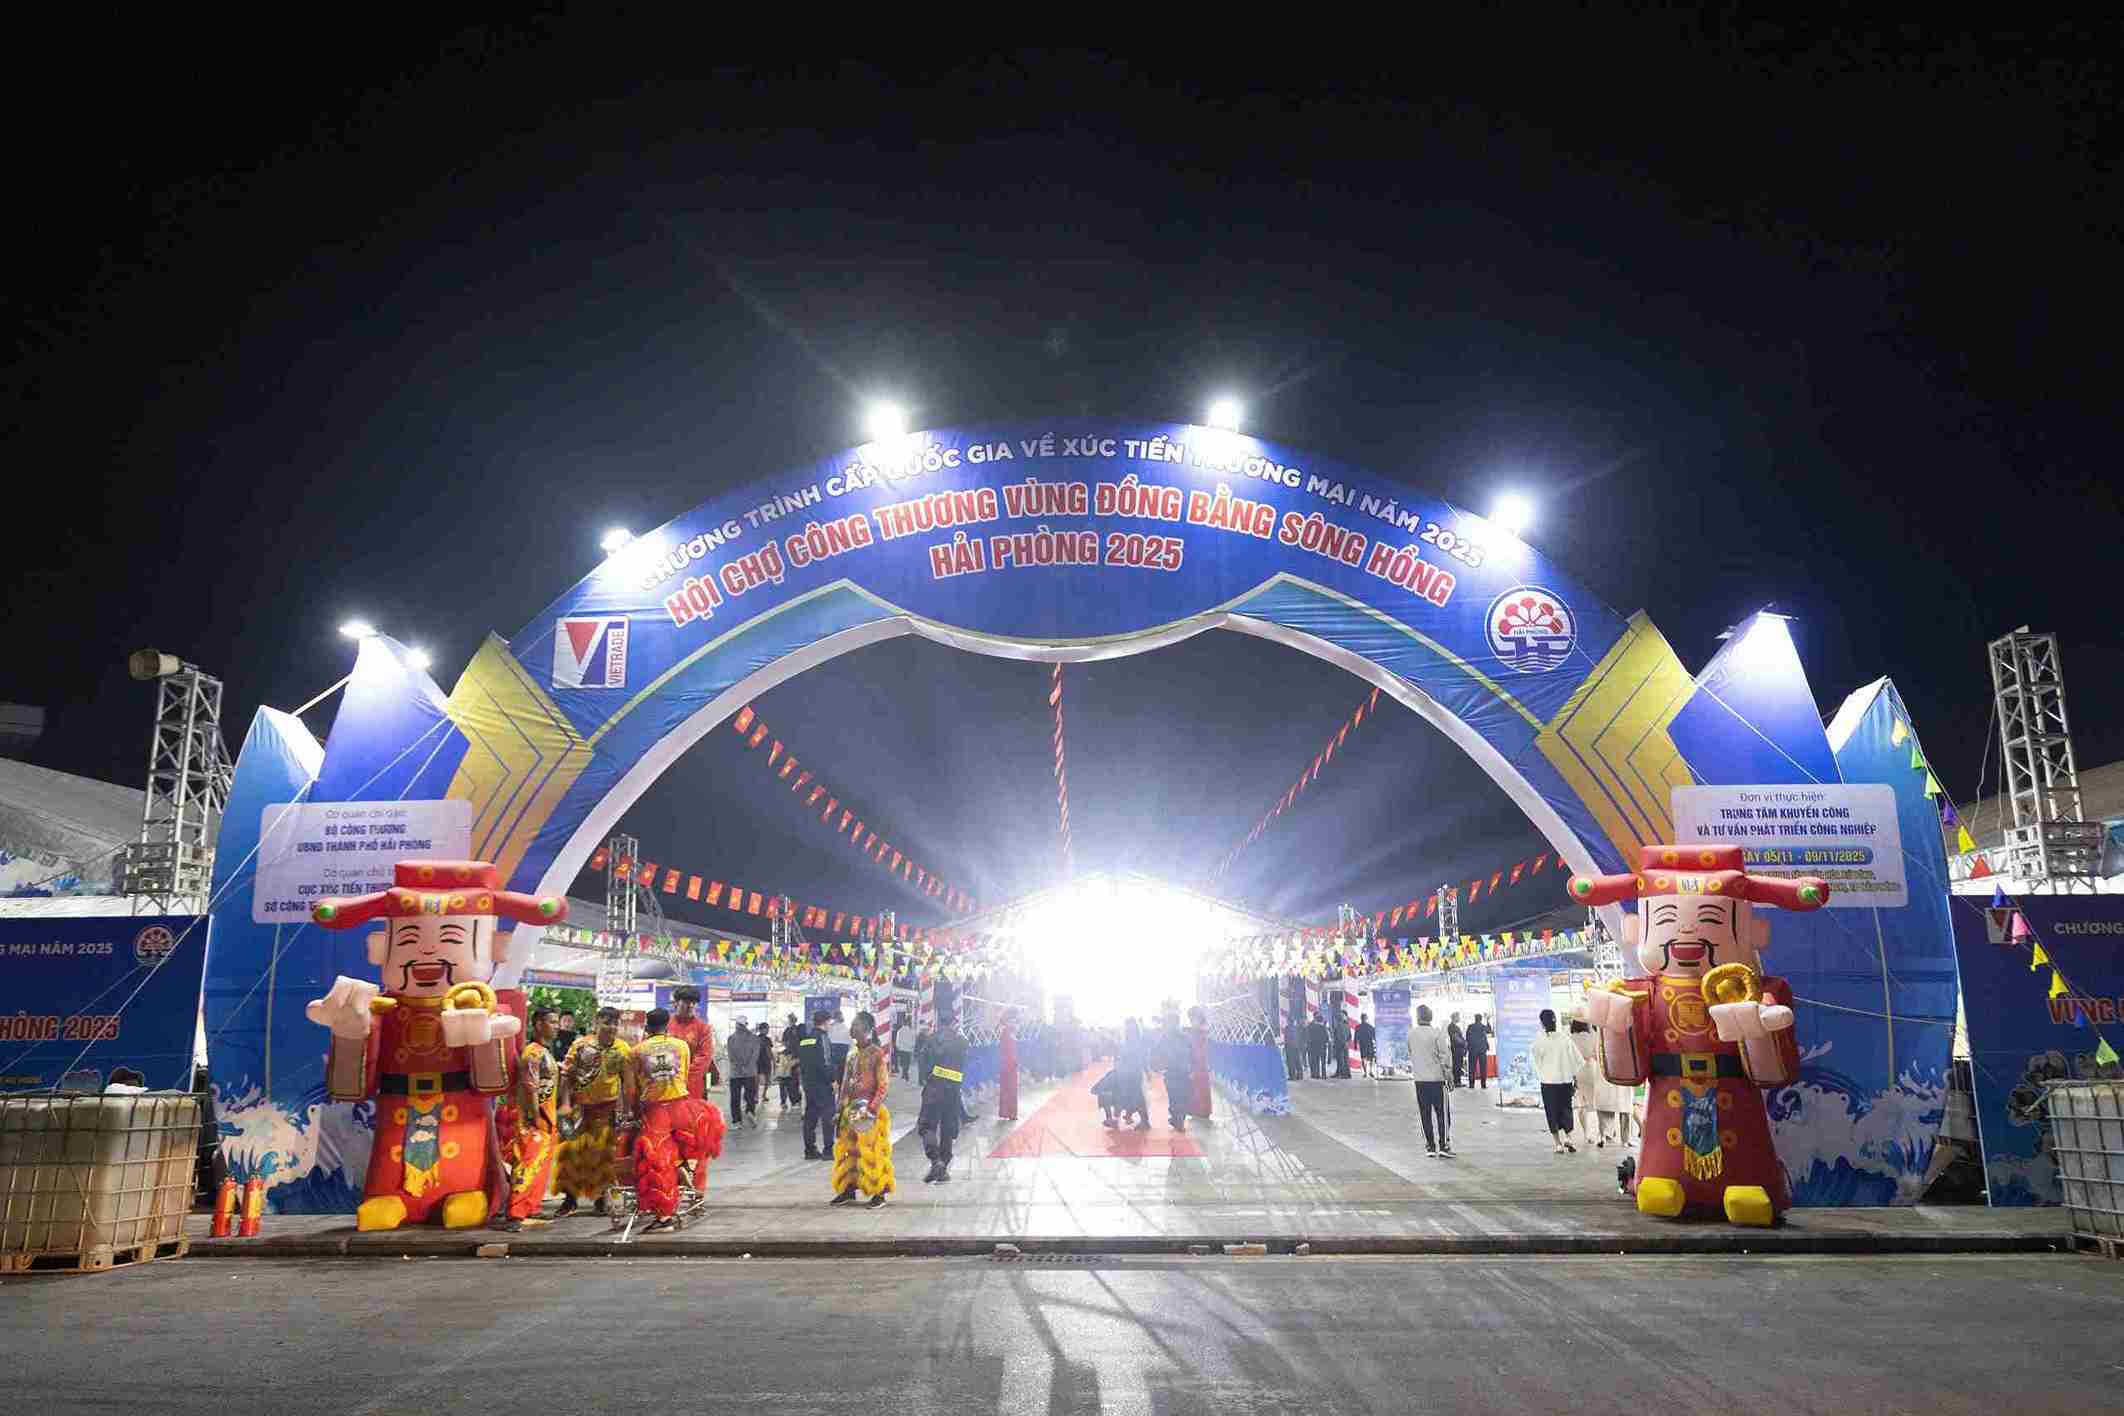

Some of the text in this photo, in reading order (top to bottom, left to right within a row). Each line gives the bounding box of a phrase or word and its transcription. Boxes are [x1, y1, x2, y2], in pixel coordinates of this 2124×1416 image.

[743, 485, 821, 528] TRÌNH
[826, 462, 879, 497] CẤP
[884, 443, 961, 480] UỐC
[967, 441, 1014, 464] GIA
[1019, 432, 1056, 458] VỀ
[1063, 433, 1116, 457] XÚC
[1124, 434, 1185, 465] TIẾN
[1306, 474, 1356, 506] MẠI
[1360, 494, 1420, 533] NĂM
[1420, 521, 1486, 569] 2025
[664, 473, 1456, 628] HỘI CHỢ CÔNG THƯƠNG VÙNG ĐỒNG BẰNG SÔNG HỒNG
[929, 525, 1184, 579] HẢI PHÒNG 2025
[607, 630, 625, 685] VIETRADE
[1720, 805, 1850, 819] TRUNG TÂM KHUYẾN CÔNG
[1697, 823, 1711, 837] VÀ
[1750, 822, 1776, 836] PHÁT
[1779, 821, 1808, 836] TRIỂN
[1810, 822, 1838, 836] CÔNG
[1840, 821, 1877, 836] NGHIỆP
[2053, 920, 2124, 935] CHƯƠNG
[41, 941, 74, 954] NĂM
[78, 942, 113, 955] 2025
[64, 1015, 120, 1041] 2025
